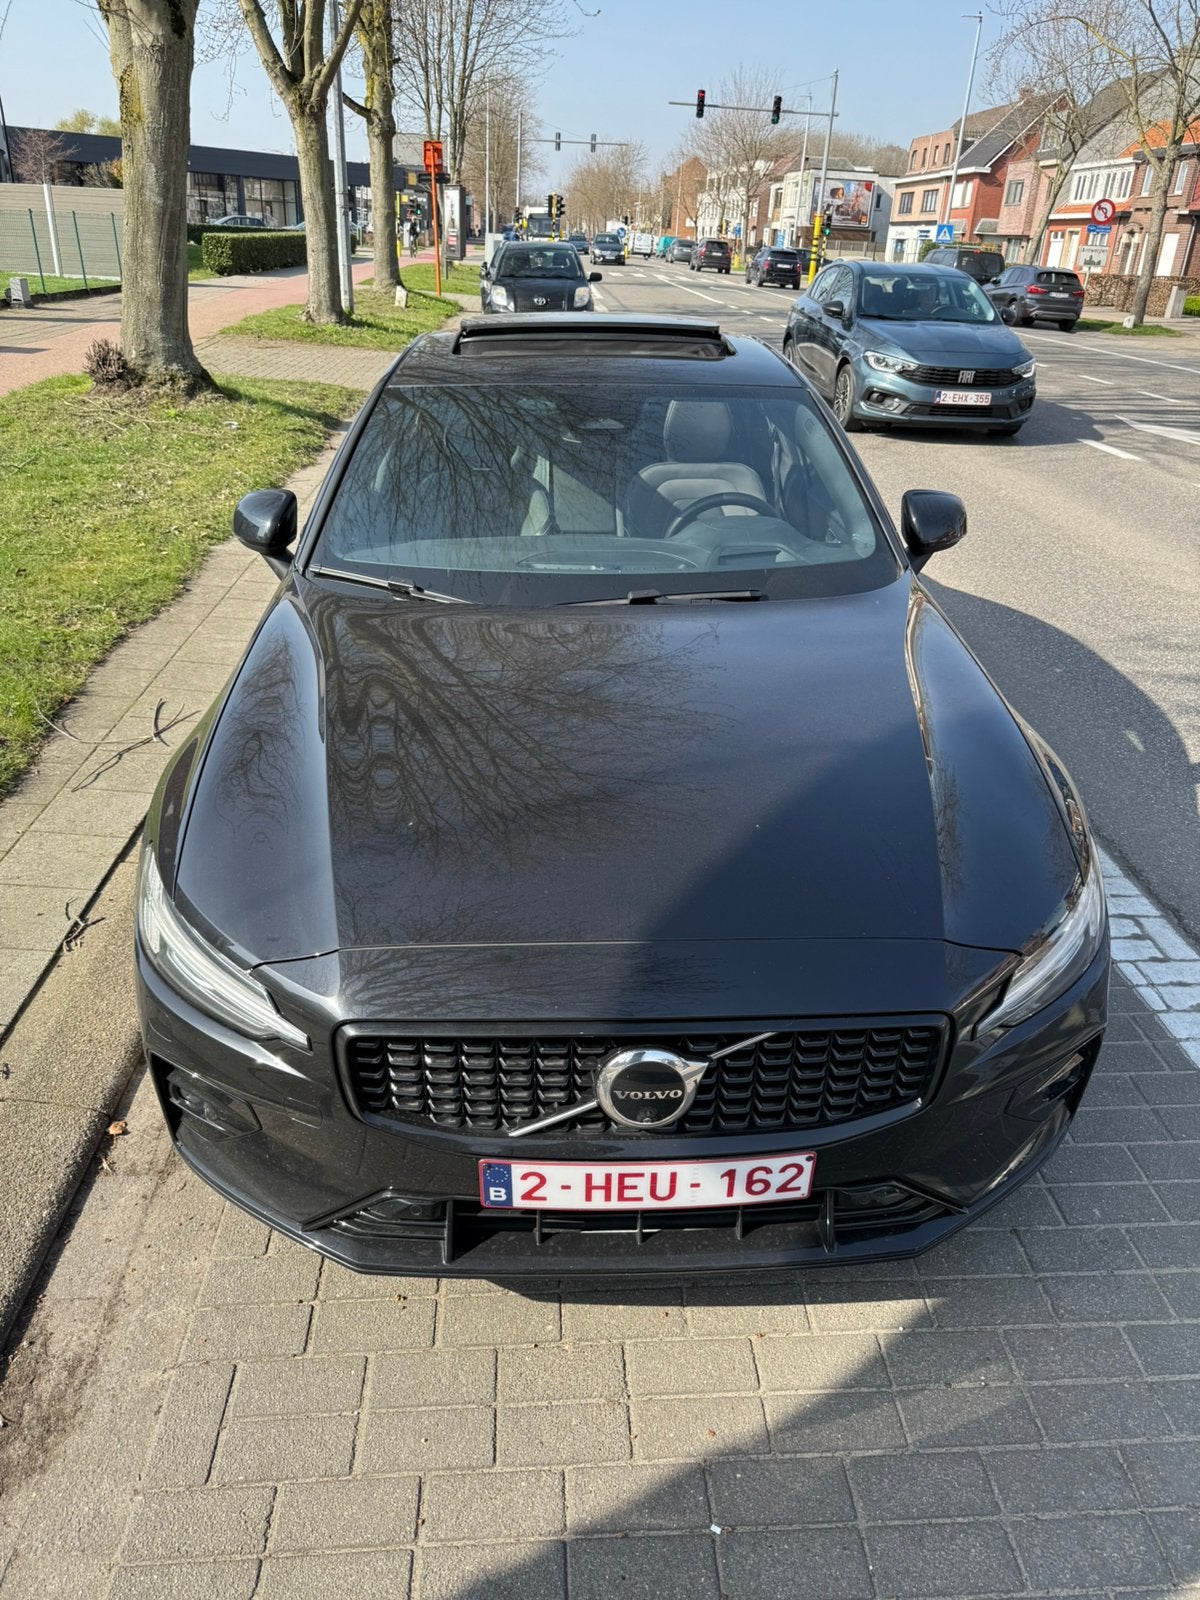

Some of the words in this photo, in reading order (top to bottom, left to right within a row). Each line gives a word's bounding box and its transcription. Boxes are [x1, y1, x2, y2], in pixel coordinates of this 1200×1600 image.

[958, 370, 976, 384] FIAT
[613, 1088, 683, 1101] VOLVO
[489, 1187, 507, 1201] B
